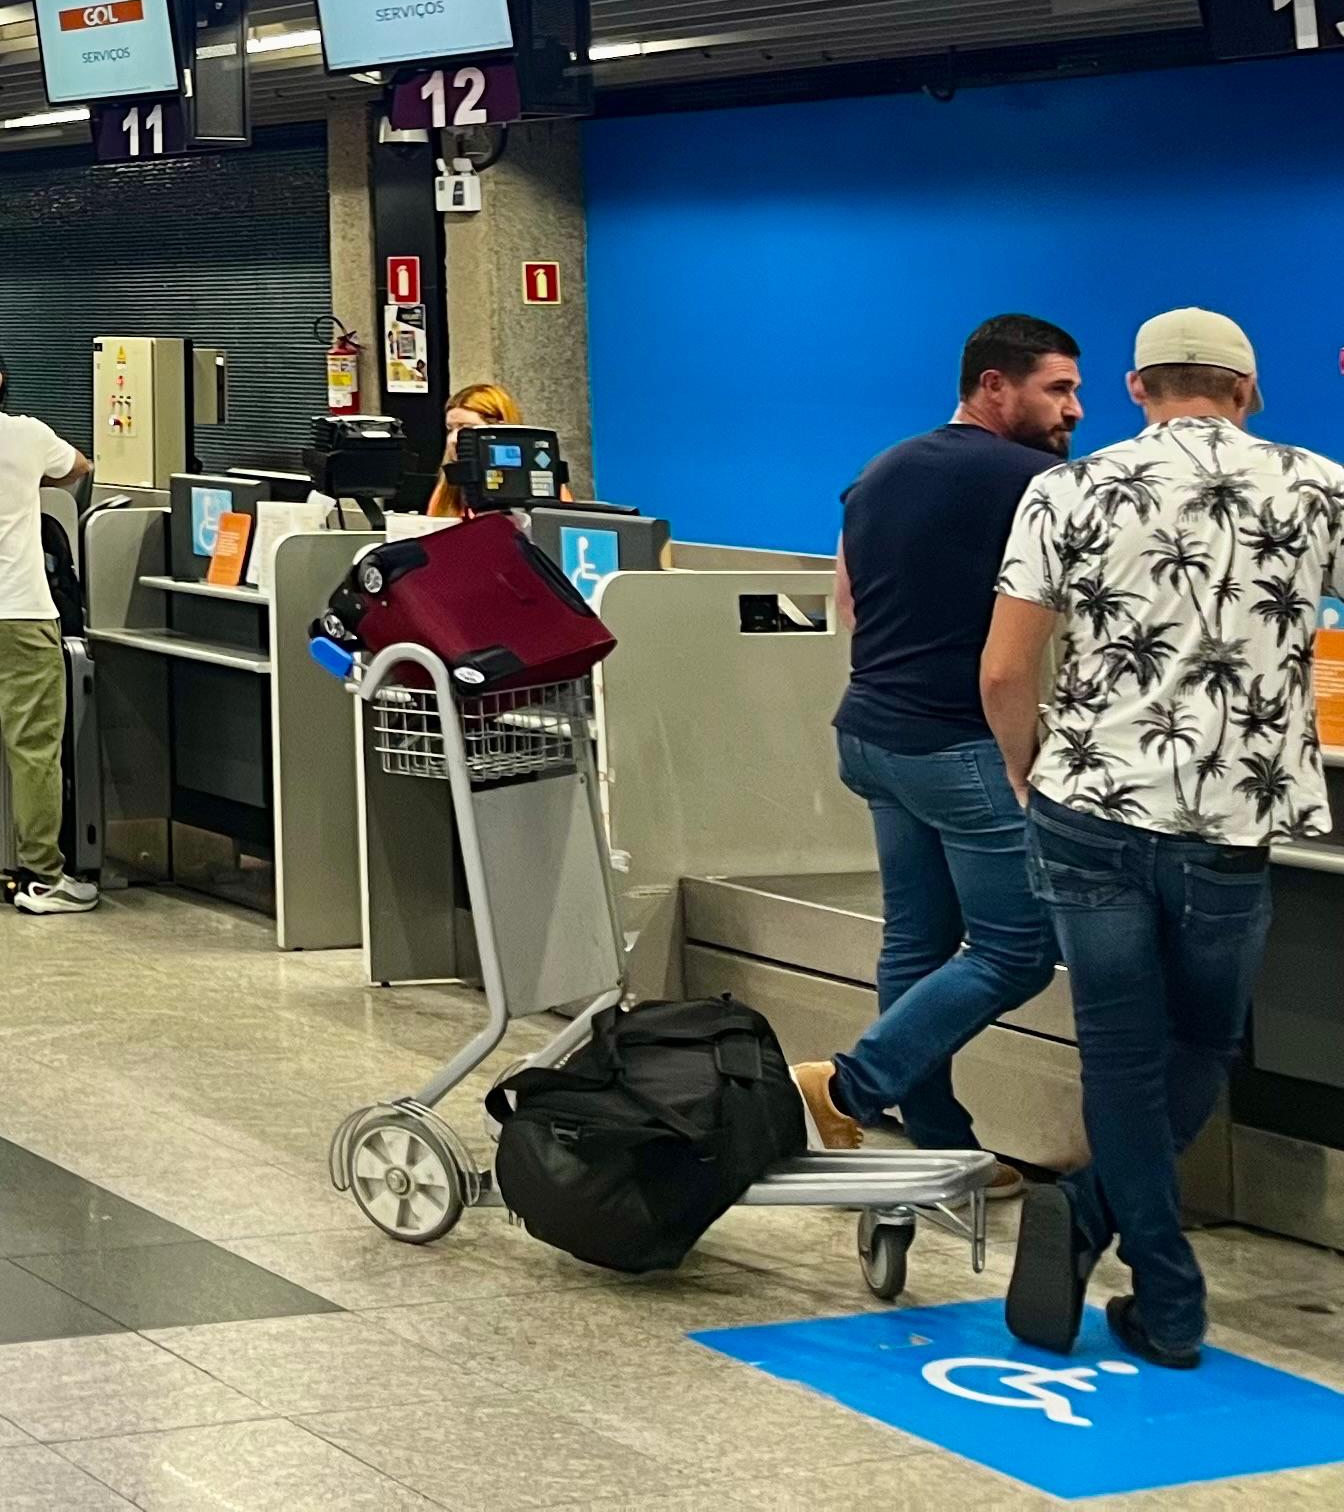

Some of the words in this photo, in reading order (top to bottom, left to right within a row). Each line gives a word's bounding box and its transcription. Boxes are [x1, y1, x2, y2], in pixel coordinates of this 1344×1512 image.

[82, 4, 119, 27] GOL
[375, 0, 445, 23] SERVIÇOS
[81, 46, 131, 64] SERVIÇOS
[420, 66, 488, 128] 12
[122, 103, 163, 156] 11
